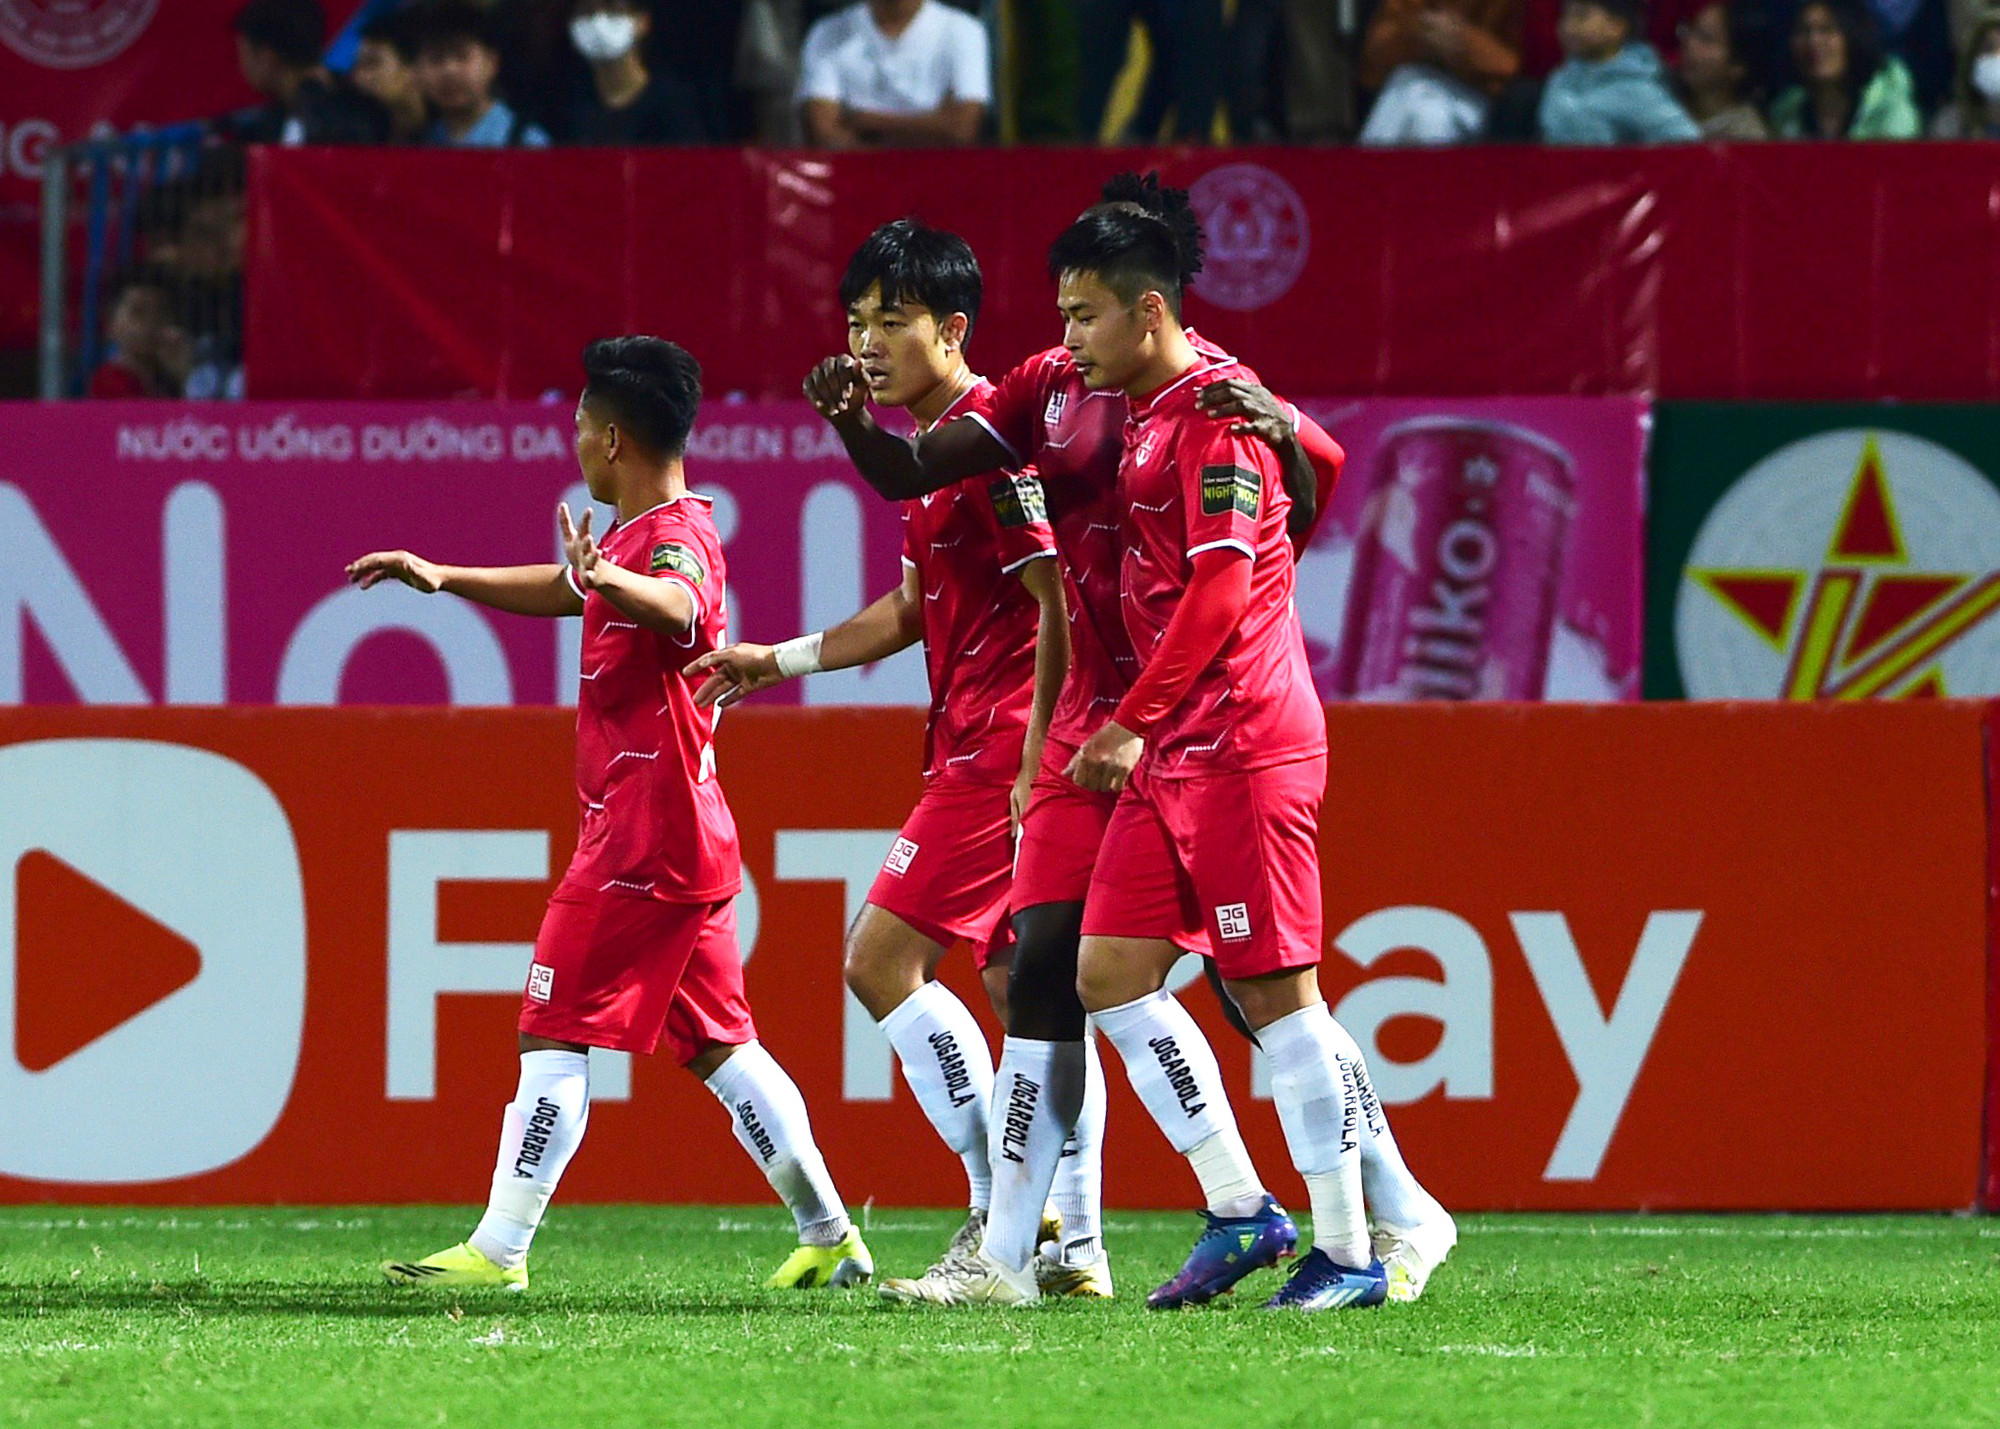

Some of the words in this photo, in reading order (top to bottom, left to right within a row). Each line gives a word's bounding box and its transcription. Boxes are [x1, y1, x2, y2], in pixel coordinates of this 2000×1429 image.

[512, 422, 566, 461] DA
[385, 829, 912, 1101] FT
[1251, 904, 1705, 1182] ay
[928, 1030, 977, 1109] JOGARBOLA
[1148, 1035, 1207, 1119] JOGARBOLA
[1335, 1053, 1358, 1154] JOGARBOLA
[512, 1096, 561, 1179] JOGARBOLA
[736, 1099, 778, 1166] JOGARBOL
[1002, 1072, 1041, 1164] JOGARBOLA
